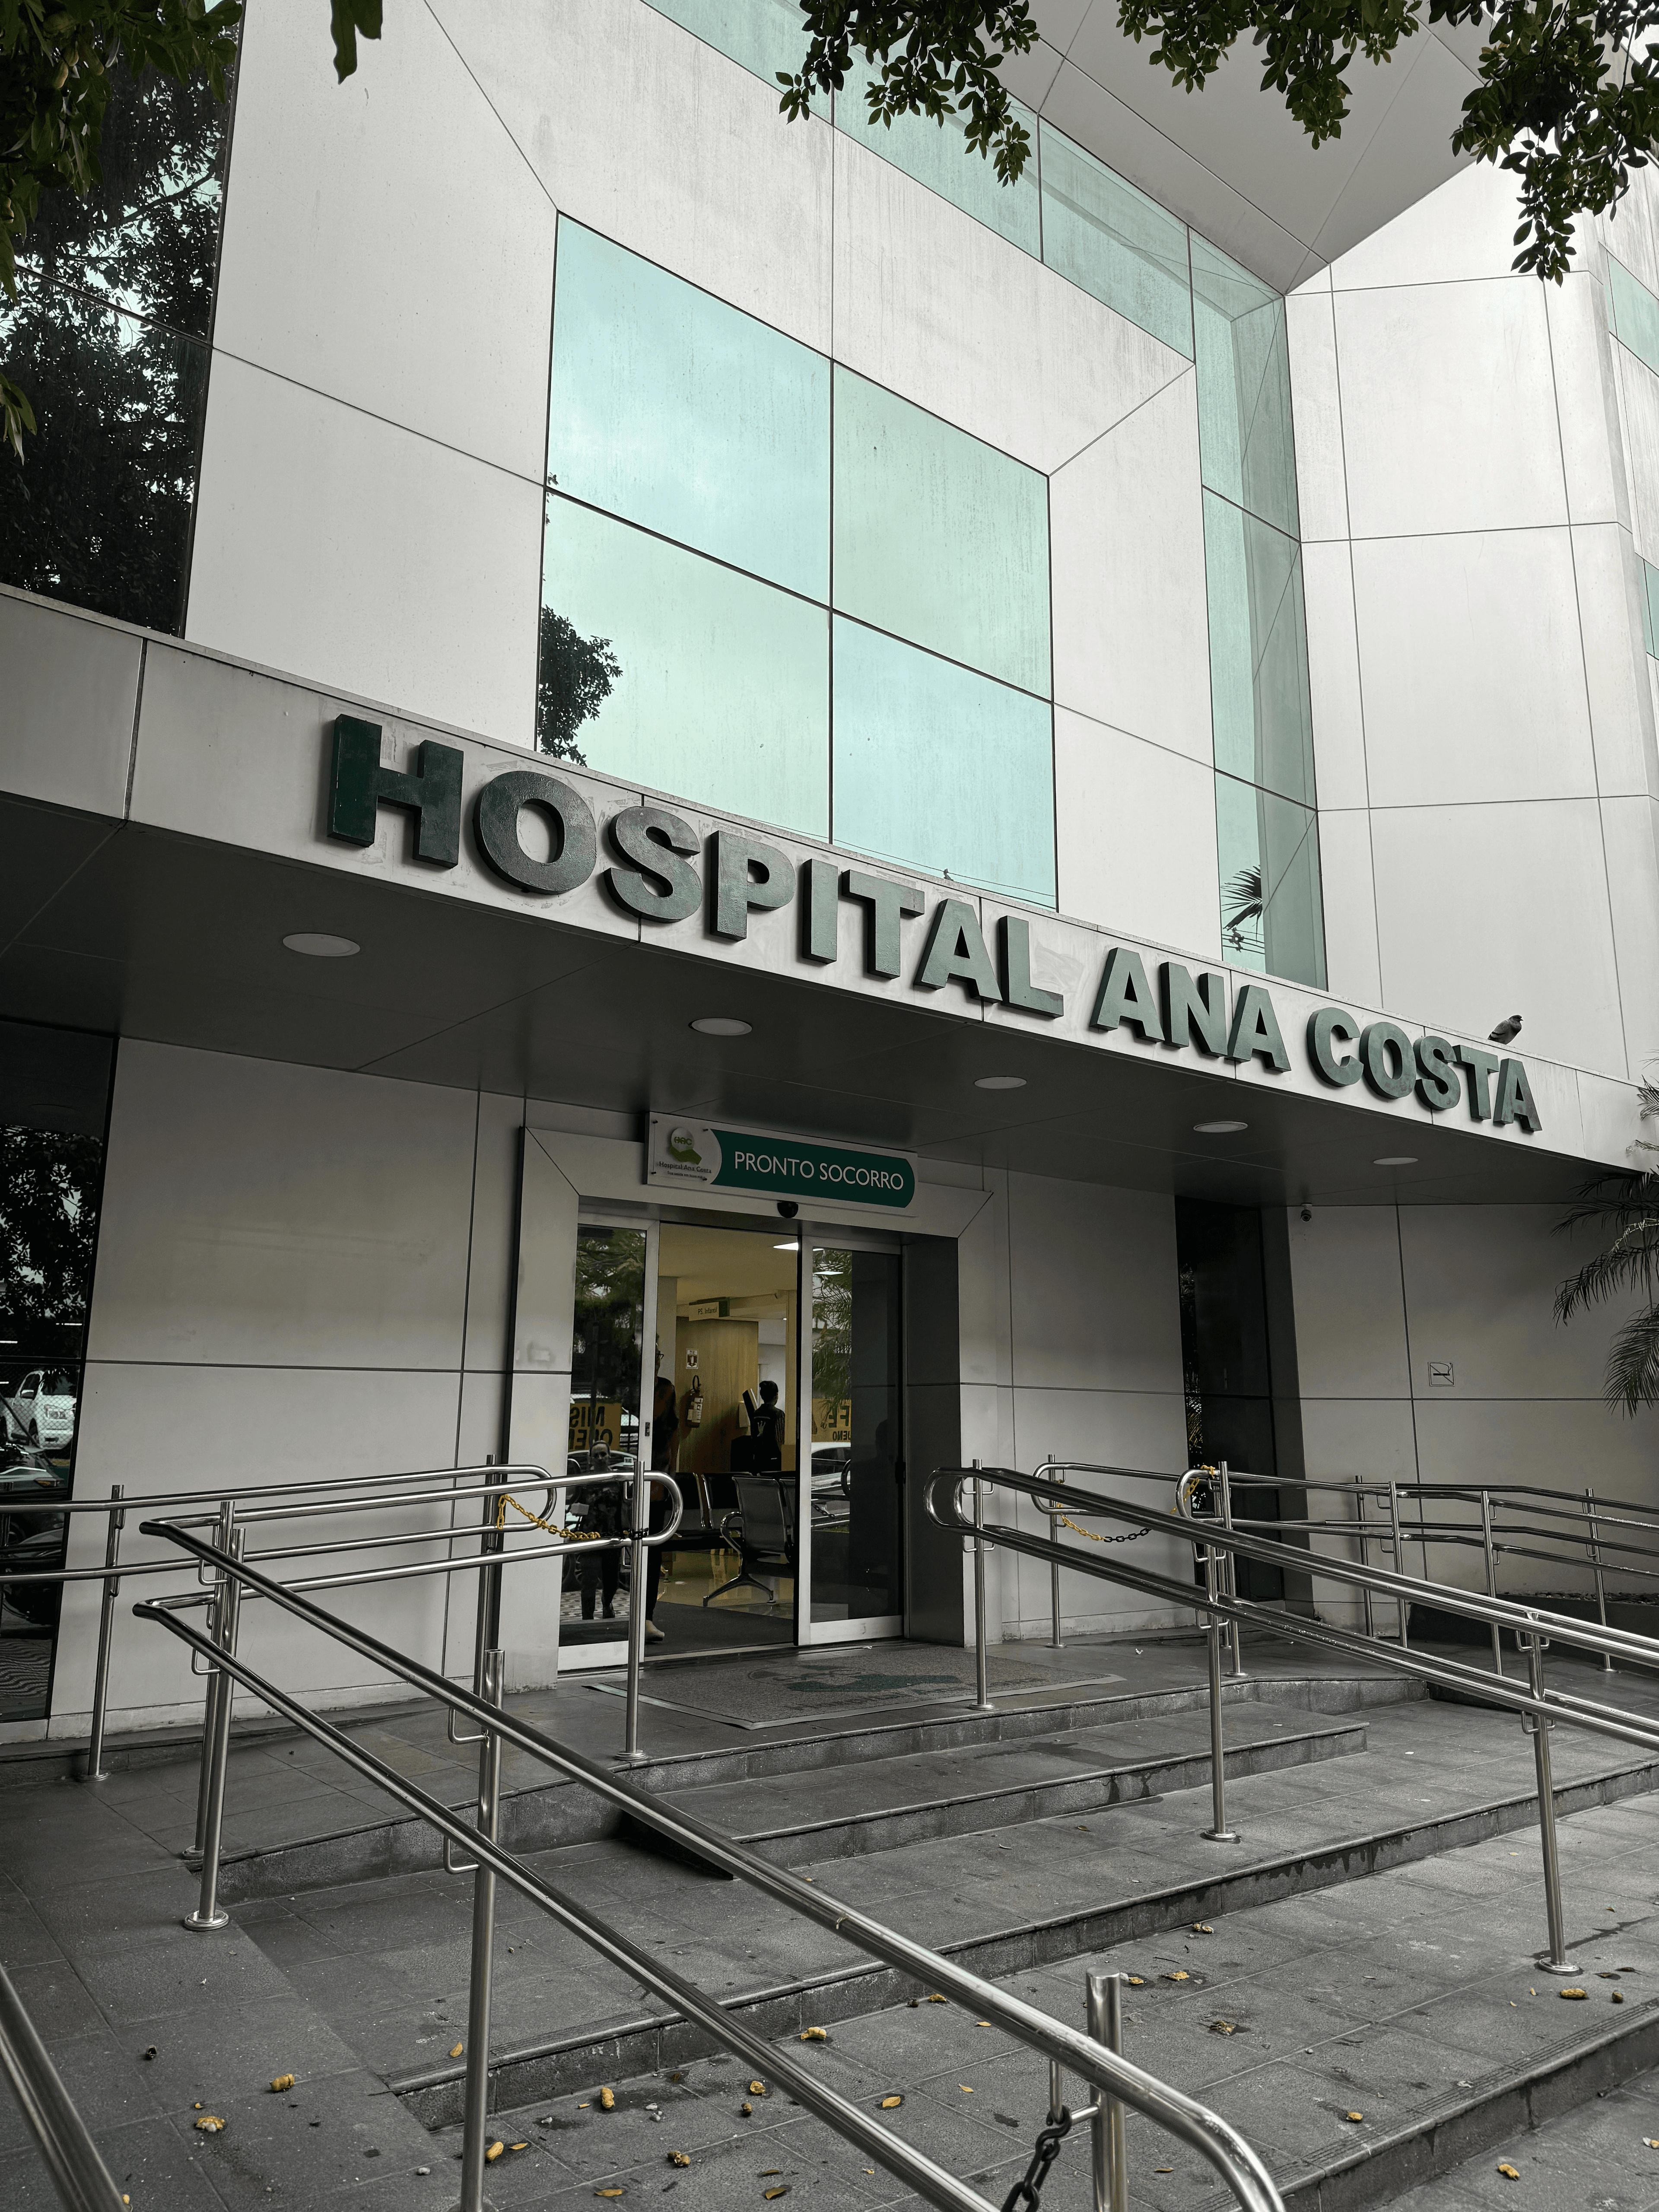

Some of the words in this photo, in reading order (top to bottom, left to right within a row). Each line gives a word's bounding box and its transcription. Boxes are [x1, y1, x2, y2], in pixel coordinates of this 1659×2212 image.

[327, 713, 1064, 1019] HOSPITAL
[1089, 947, 1292, 1073] ANA
[1306, 1007, 1543, 1132] COSTA
[659, 1161, 682, 1170] Hospital
[734, 1151, 814, 1179] PRONTO
[819, 1163, 904, 1190] SOCORRO
